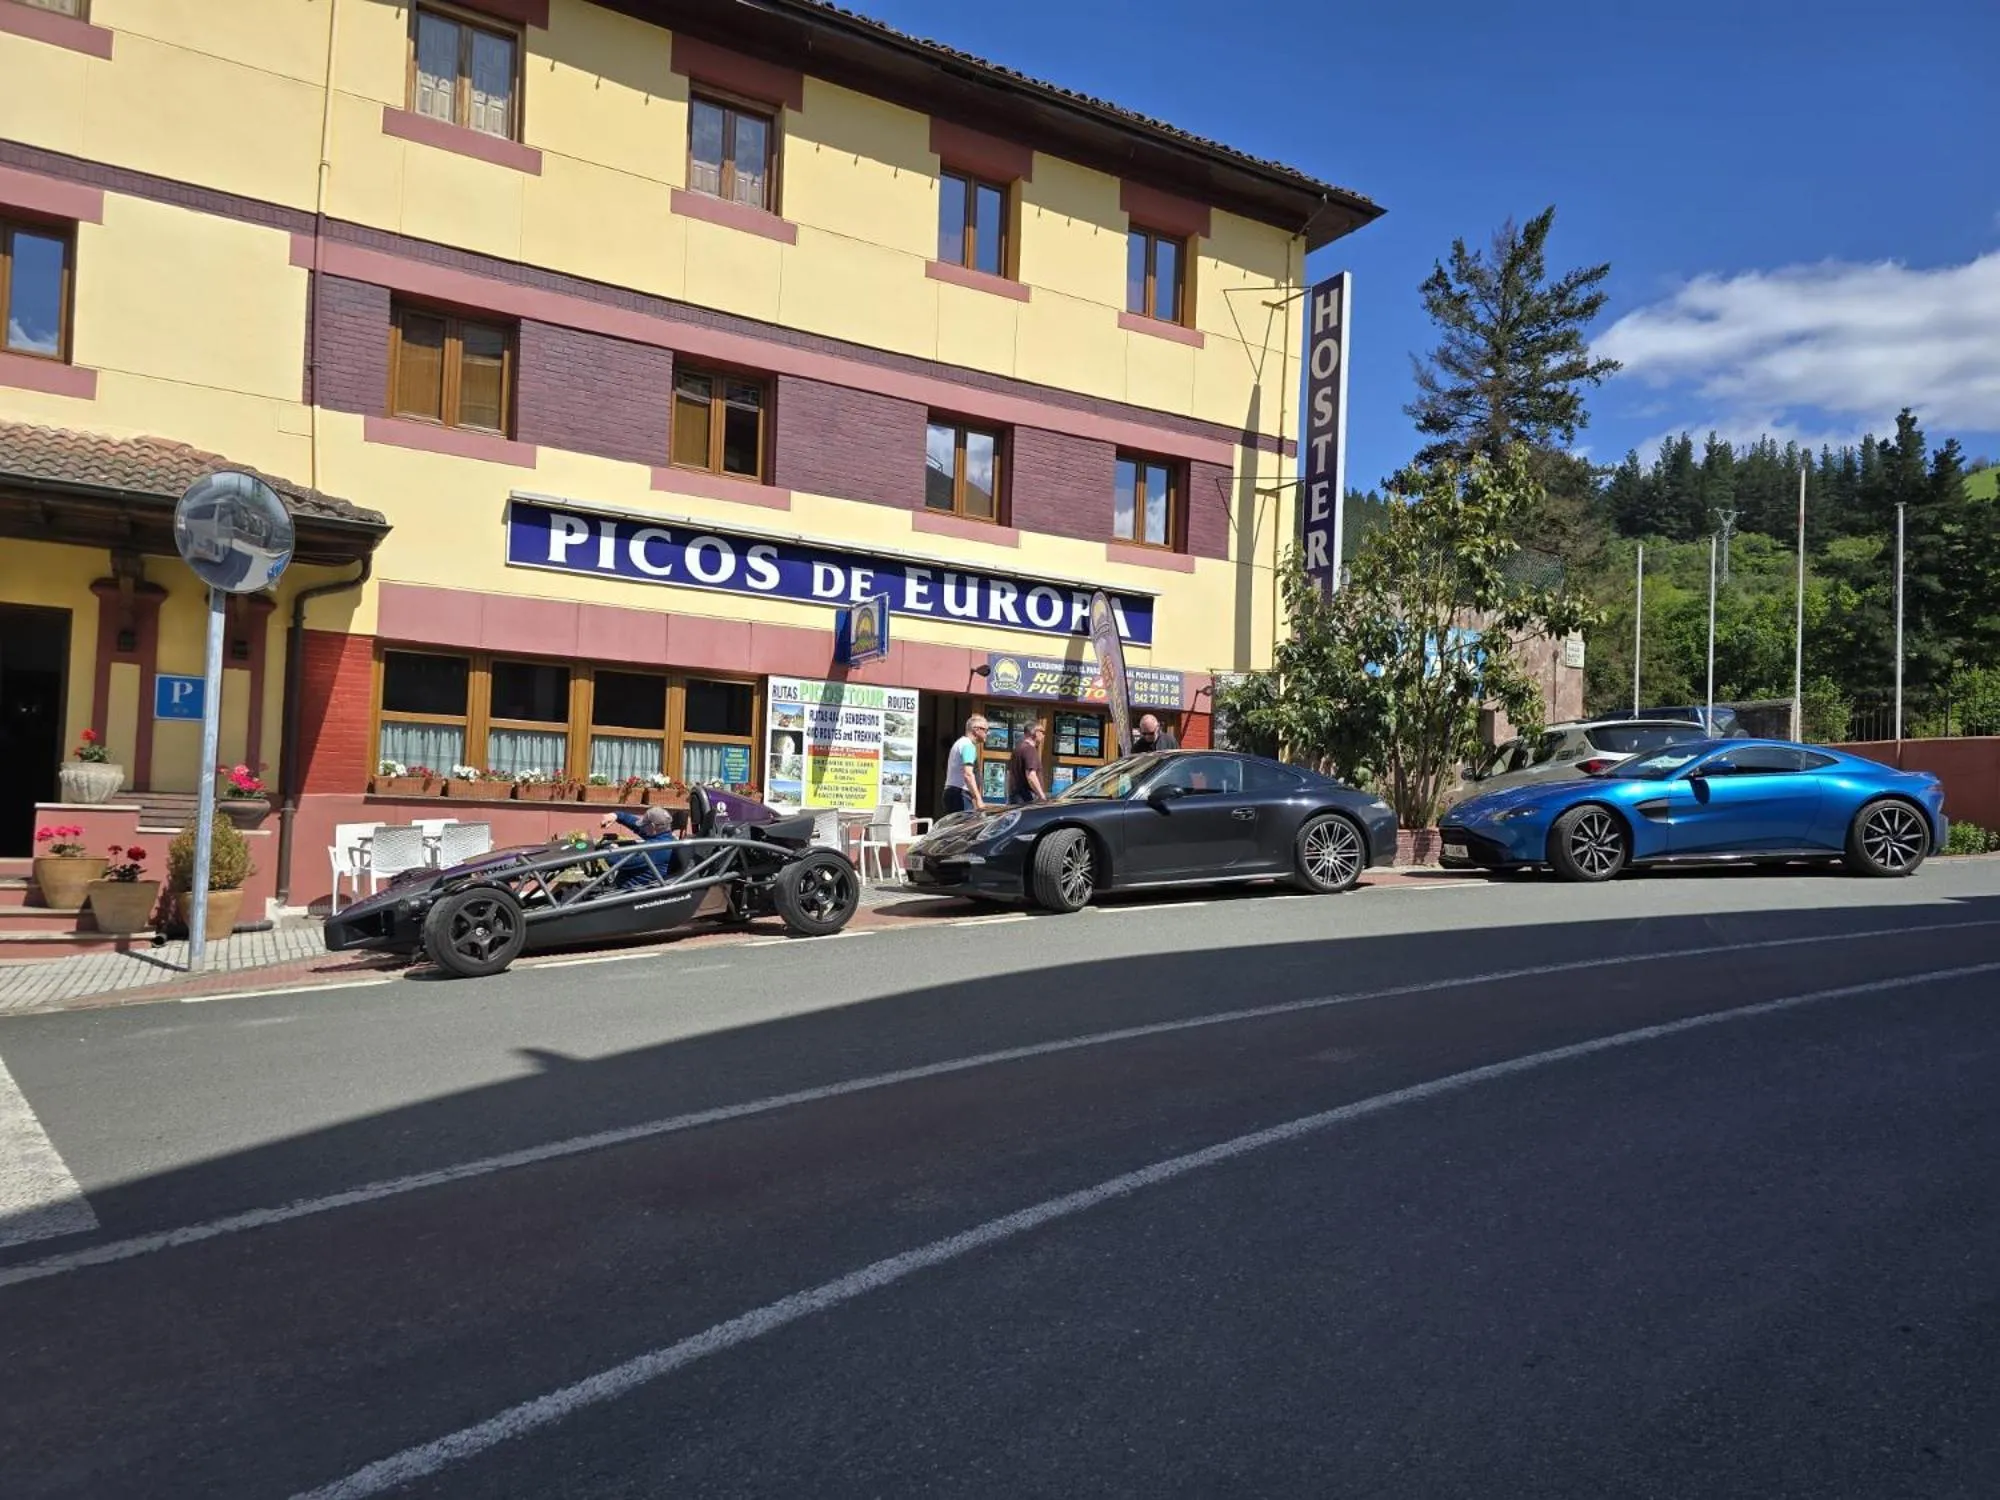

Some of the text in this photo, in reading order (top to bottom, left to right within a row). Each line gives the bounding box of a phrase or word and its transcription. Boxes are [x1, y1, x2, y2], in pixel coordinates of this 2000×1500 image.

[547, 513, 781, 591] PICOS
[811, 560, 873, 601] DE
[1033, 672, 1092, 686] RUTAS
[171, 681, 193, 704] P
[772, 684, 798, 700] RUTAS
[887, 695, 916, 710] ROUTES
[1027, 683, 1107, 698] PICOSTO
[854, 729, 882, 743] TREKKING
